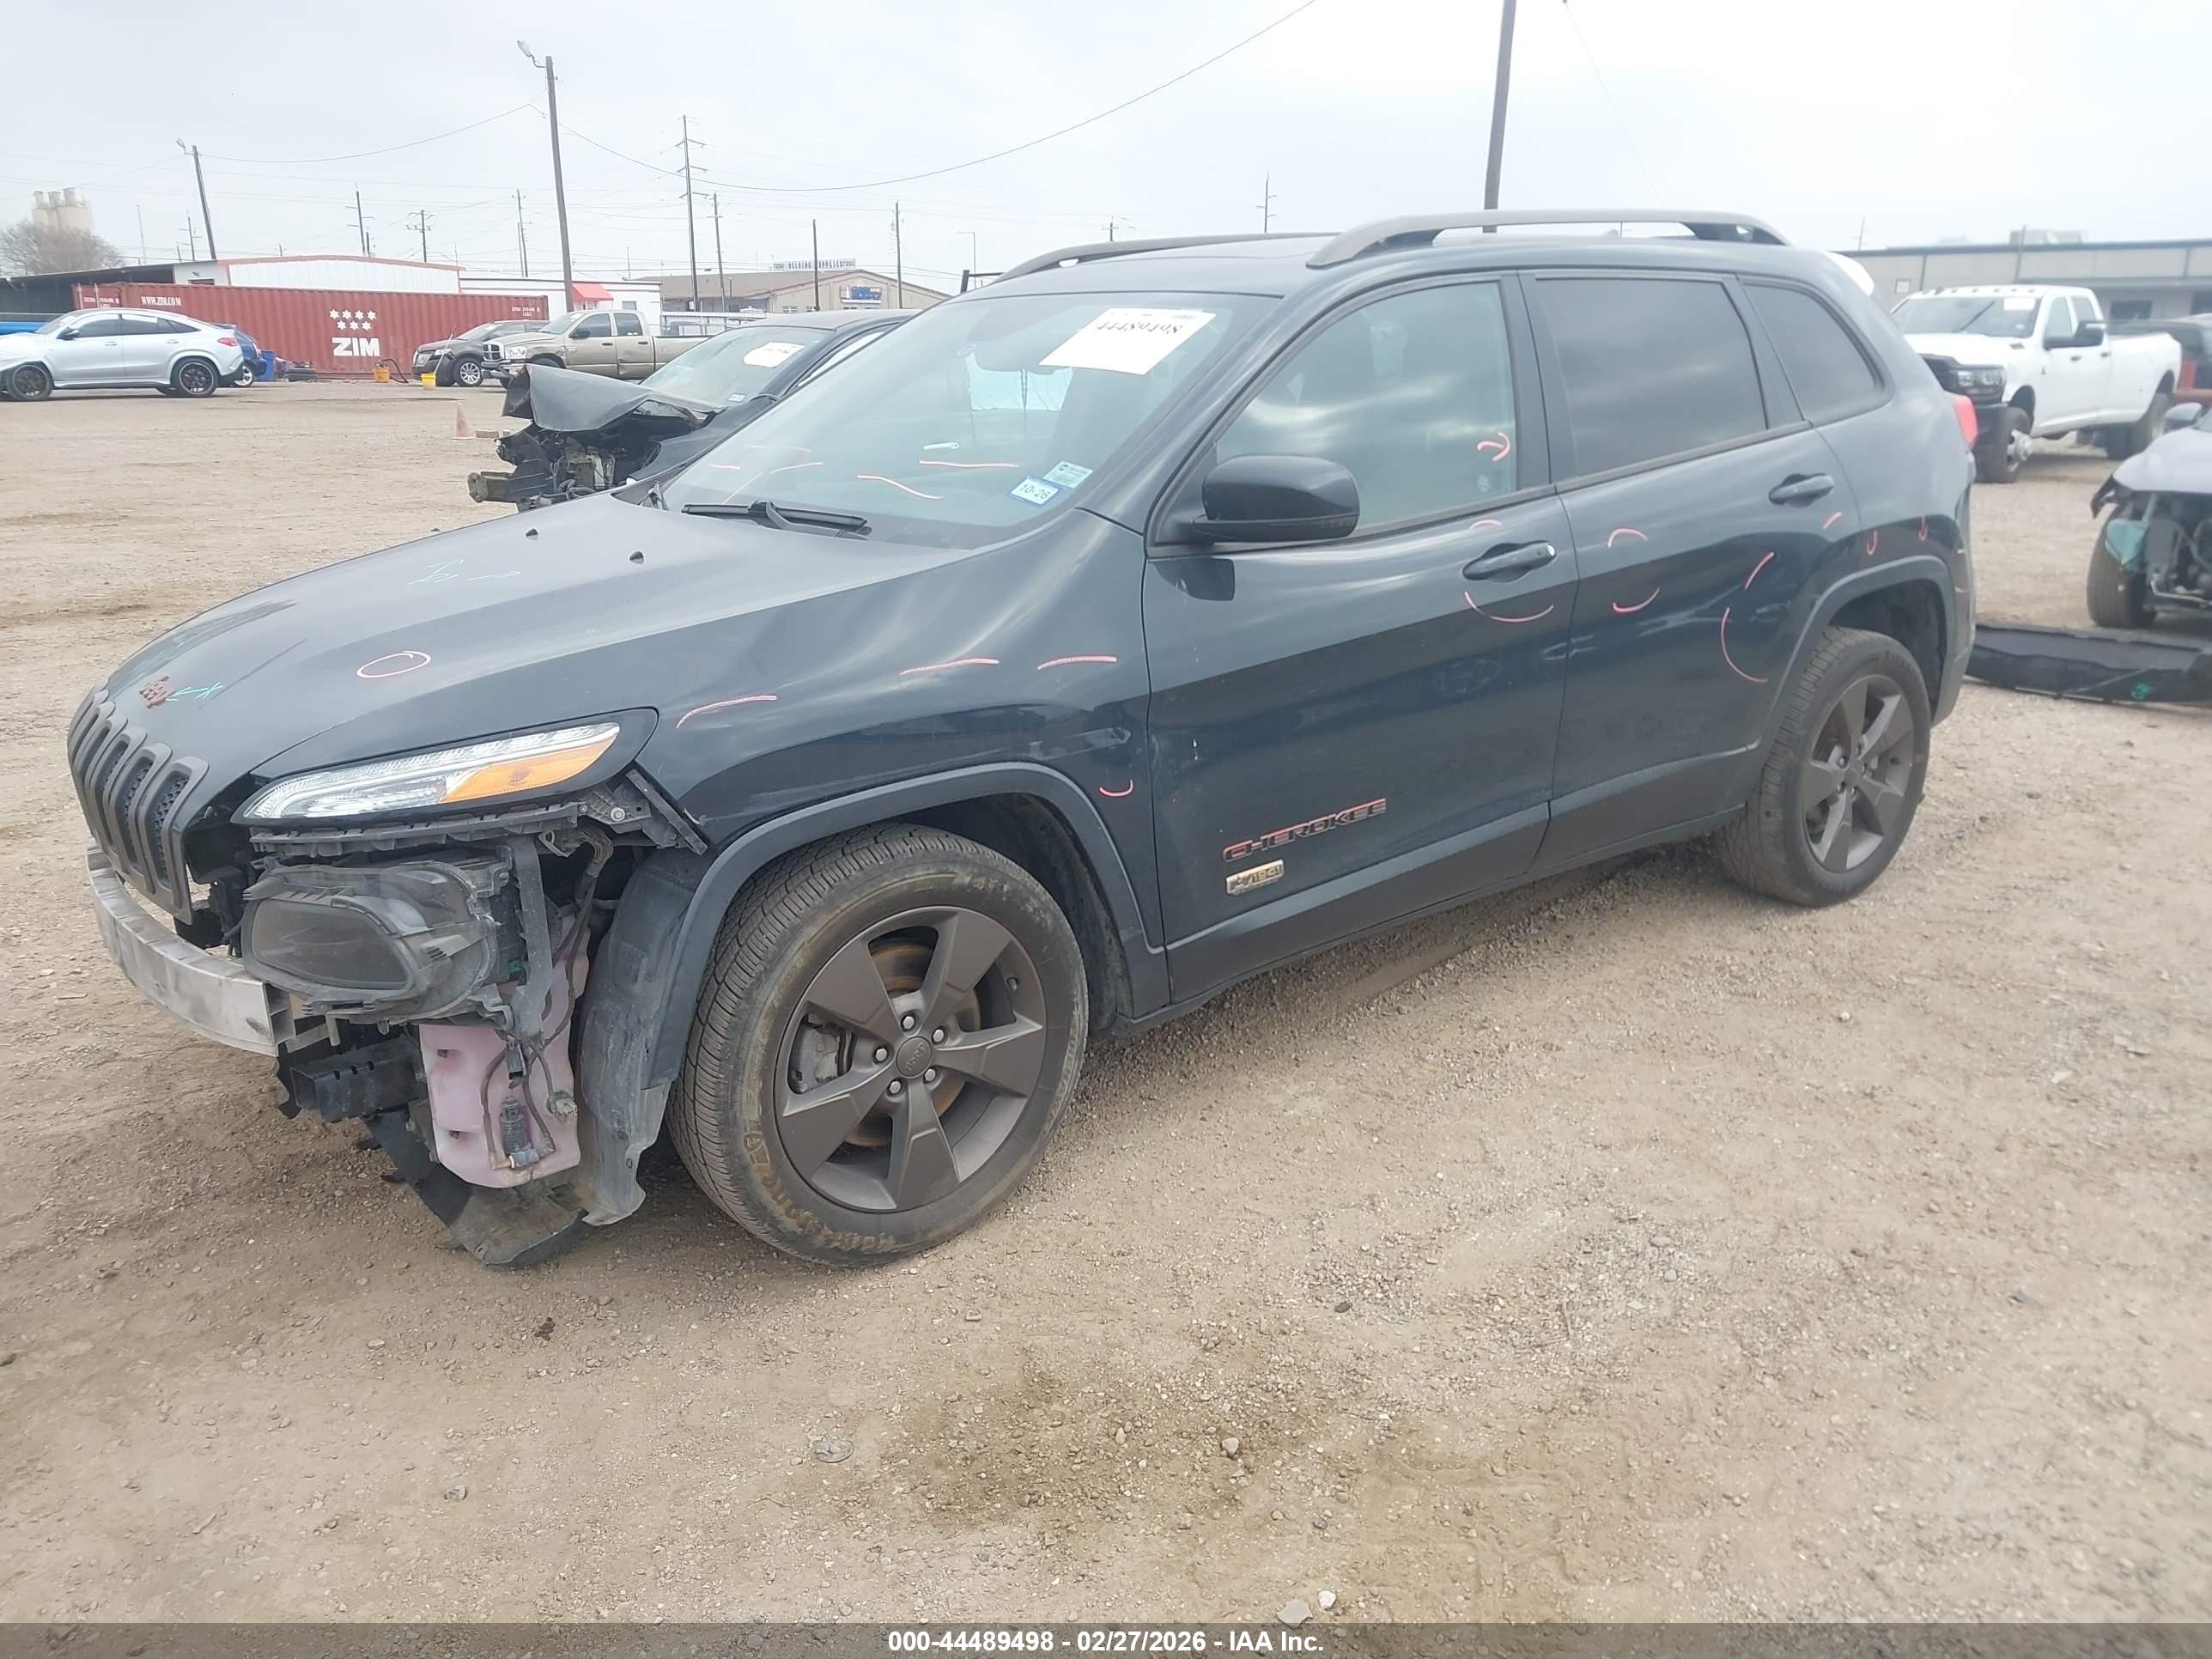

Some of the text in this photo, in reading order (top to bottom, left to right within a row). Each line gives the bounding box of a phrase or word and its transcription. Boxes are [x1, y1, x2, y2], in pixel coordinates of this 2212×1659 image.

[331, 337, 380, 356] ZIM
[1019, 483, 1052, 501] 10-26
[1222, 798, 1387, 862] CHEROKEE
